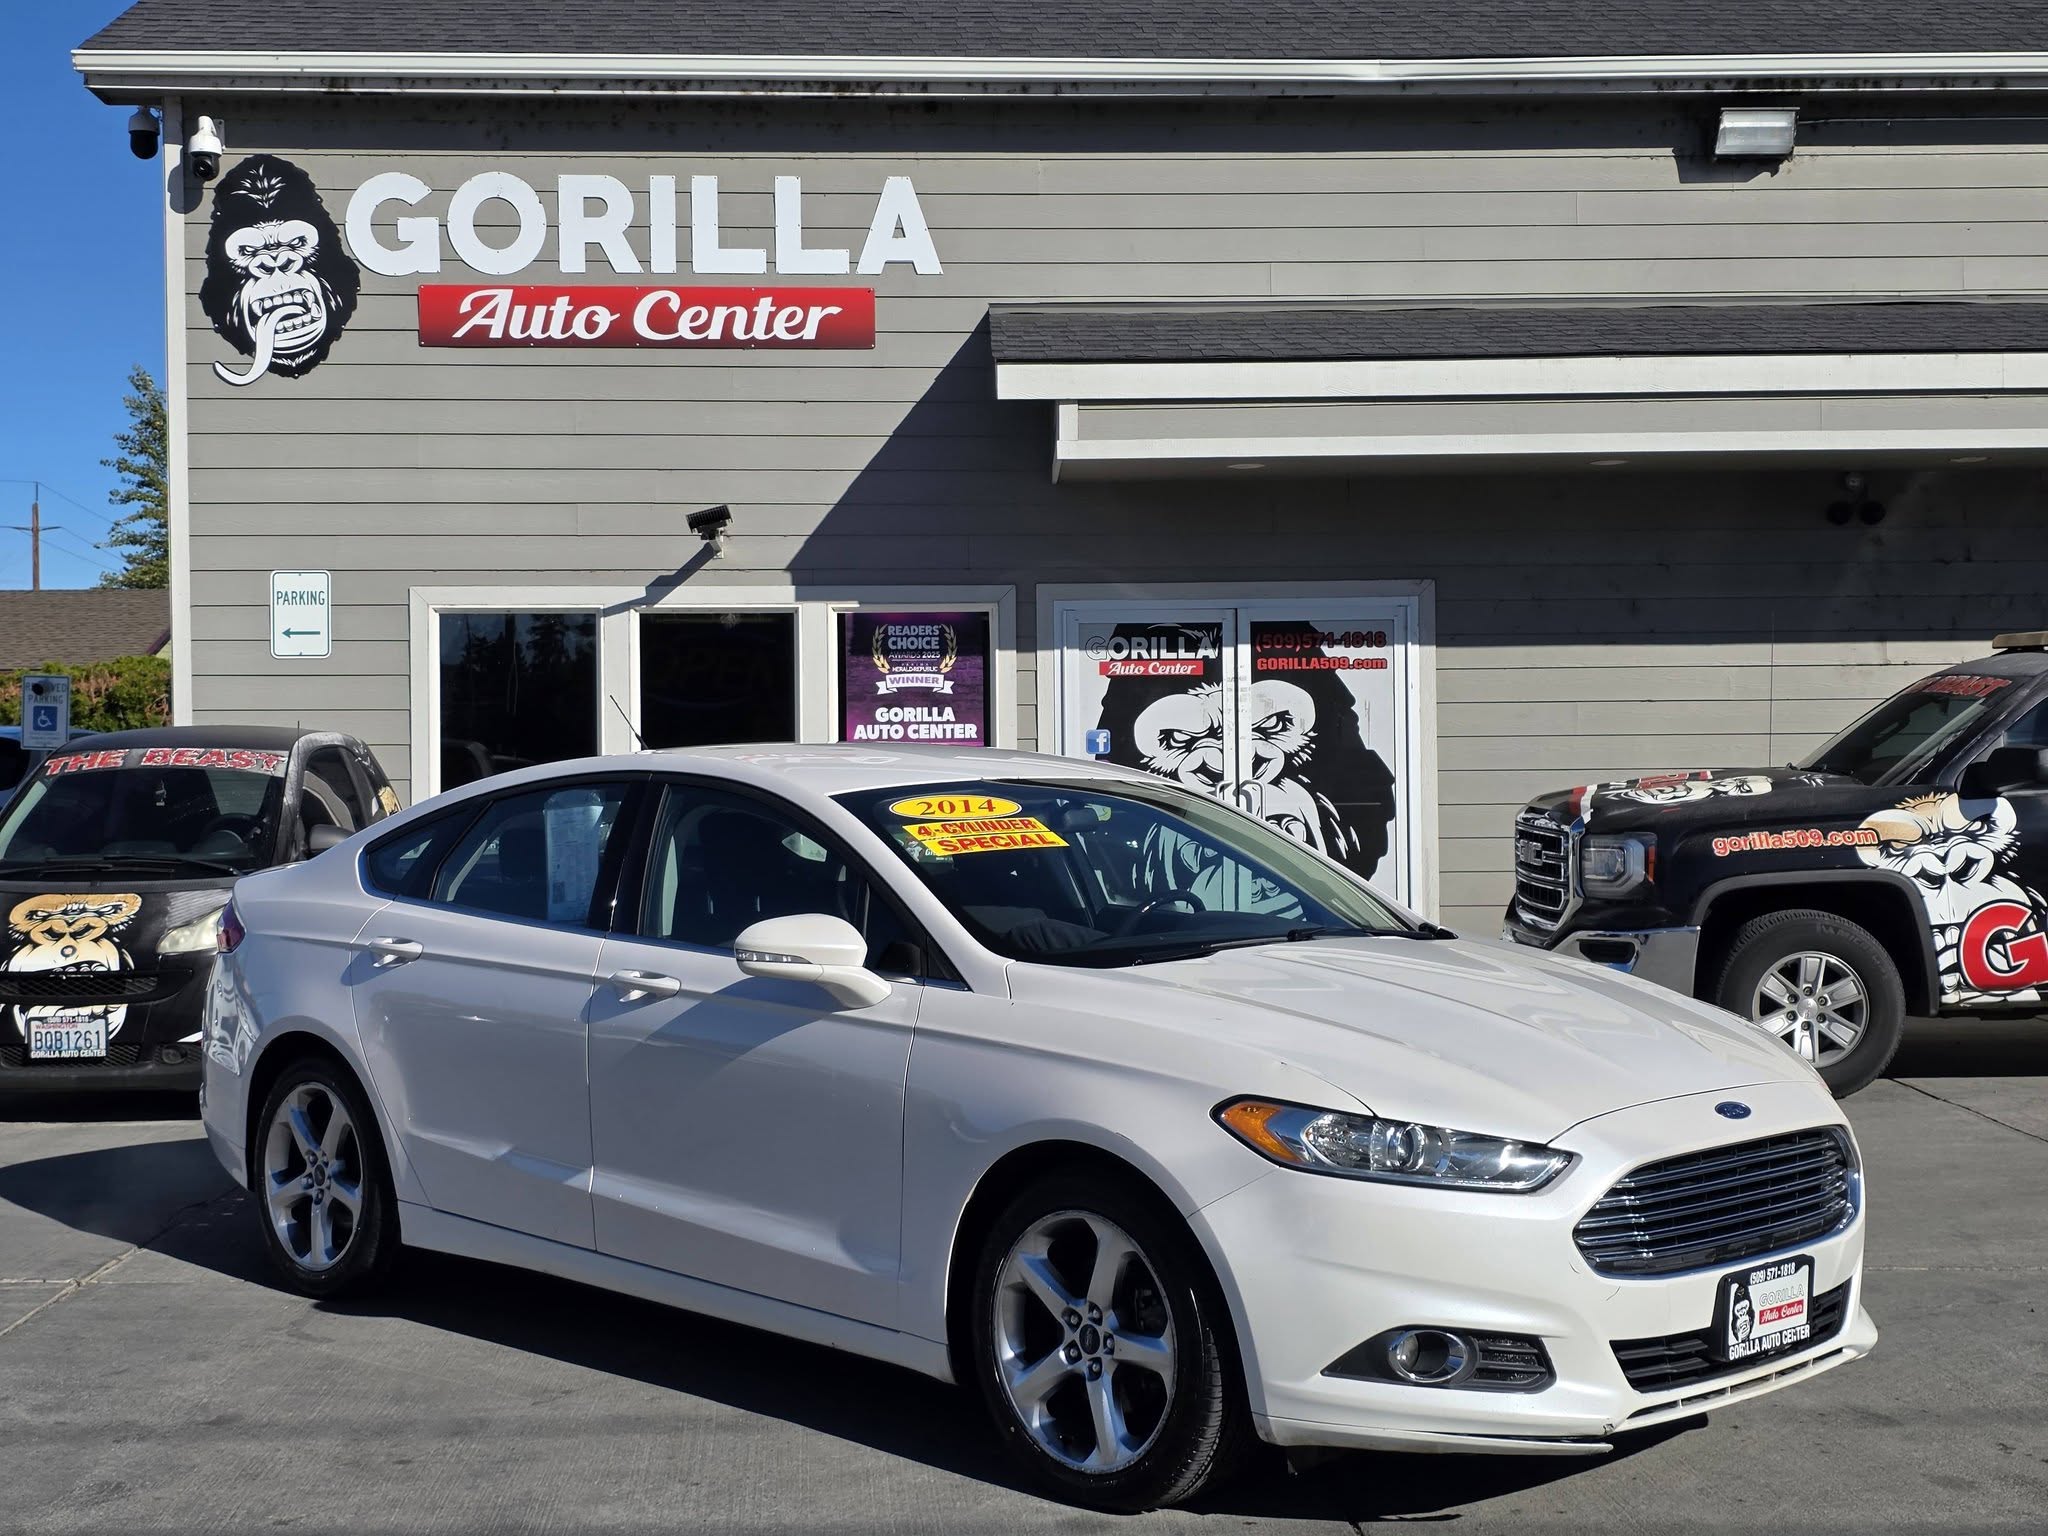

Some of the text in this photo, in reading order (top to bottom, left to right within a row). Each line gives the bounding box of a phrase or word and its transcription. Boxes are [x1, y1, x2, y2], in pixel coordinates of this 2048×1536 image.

[345, 172, 944, 276] GORILLA
[453, 288, 842, 341] Auto Center
[276, 590, 325, 606] PARKING
[887, 625, 942, 636] READERS'
[887, 637, 940, 649] CHOICE
[1085, 636, 1217, 660] GORILLA
[888, 651, 941, 659] AWARDS 2025
[1256, 656, 1388, 670] GORILLA509.com
[1108, 661, 1196, 675] Auto Center
[888, 676, 940, 685] WINNER
[28, 694, 64, 704] PARKING
[875, 706, 956, 723] GORILLA
[854, 724, 978, 740] AUTO CENTER
[45, 747, 288, 775] THE BEAST
[916, 798, 996, 816] 2014
[917, 818, 1038, 838] 4-CYLINDER
[937, 834, 1059, 852] SPECIAL
[1712, 828, 1878, 856] gorilla509.com
[61, 1050, 79, 1058] AUTO
[1750, 1262, 1795, 1285] (509) 571-1818
[1759, 1284, 1804, 1307] GORILLA
[1761, 1303, 1803, 1323] Auto Center
[1761, 1332, 1780, 1351] AUTO
[1782, 1324, 1810, 1345] CENTER
